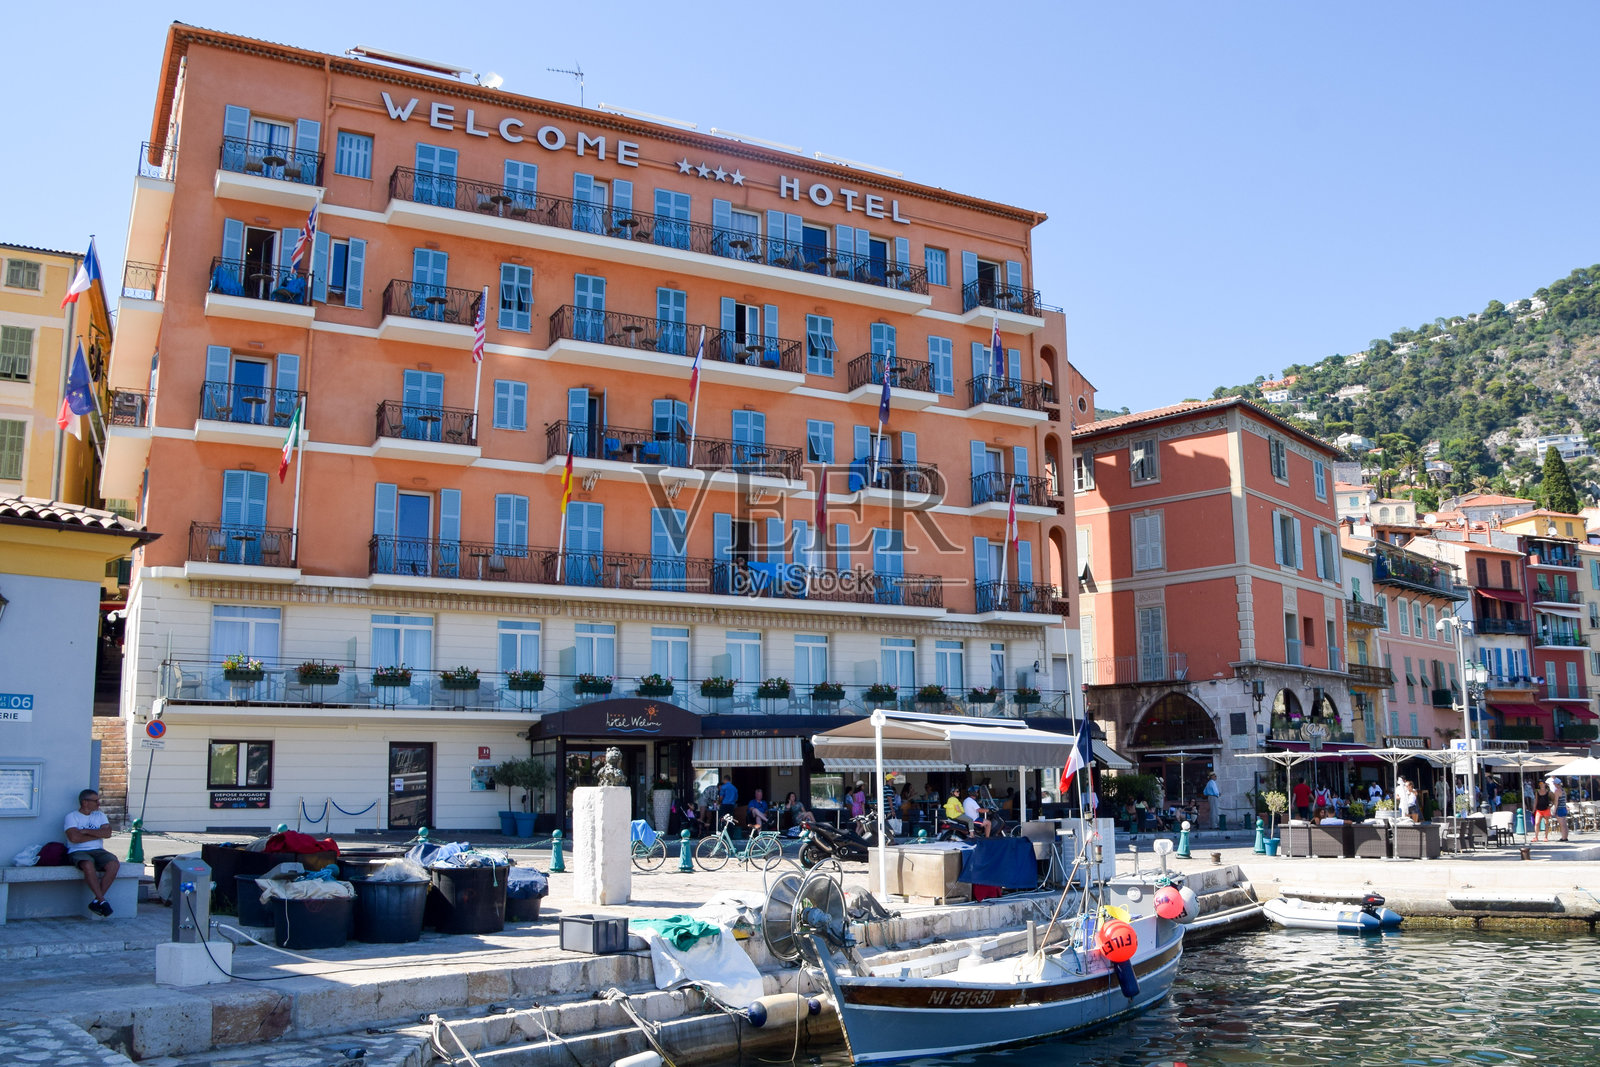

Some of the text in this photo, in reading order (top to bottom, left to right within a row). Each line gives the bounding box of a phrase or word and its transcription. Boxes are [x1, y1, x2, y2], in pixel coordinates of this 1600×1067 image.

[381, 91, 911, 224] WELCOME HOTEL
[11, 696, 31, 708] 06
[1391, 738, 1425, 748] TRASTEVERE
[927, 990, 996, 1006] NI 151550
